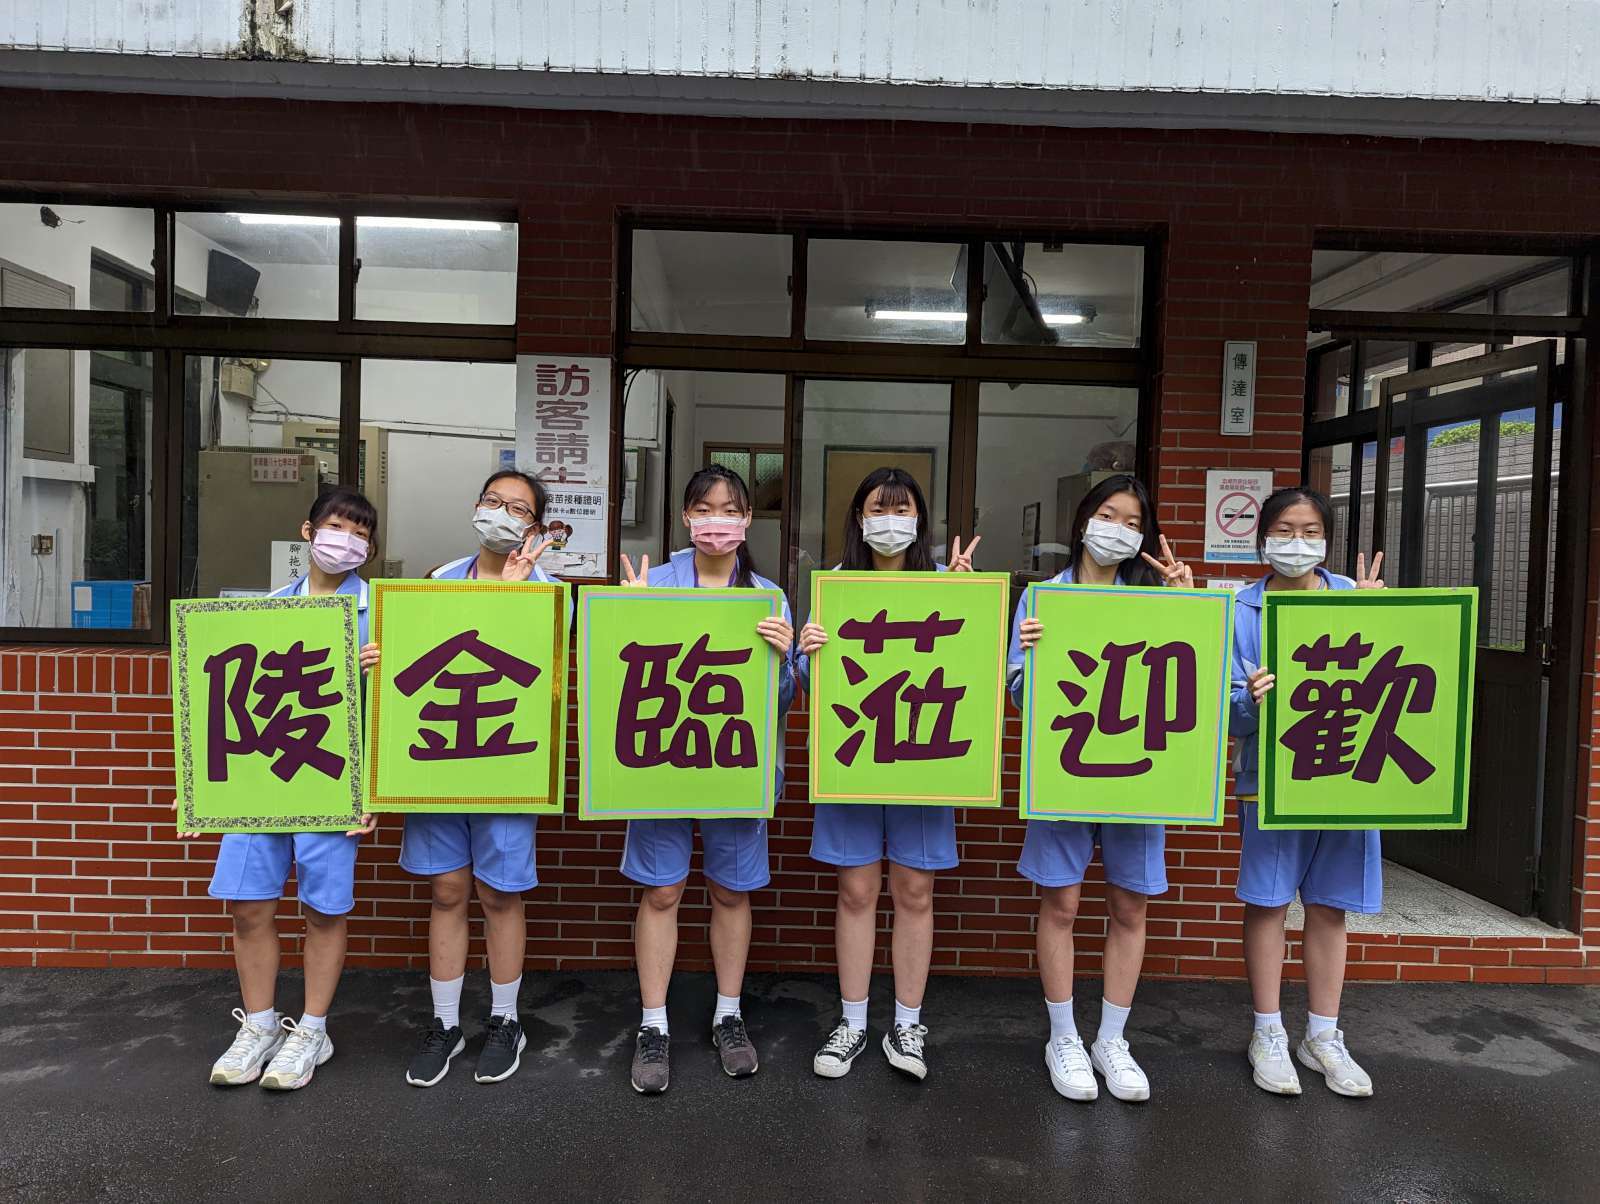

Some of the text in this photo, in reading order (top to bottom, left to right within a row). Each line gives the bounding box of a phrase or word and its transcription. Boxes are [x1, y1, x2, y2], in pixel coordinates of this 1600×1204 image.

[1231, 352, 1249, 424] 傳達室
[203, 640, 346, 782] 陵
[394, 629, 542, 761] 金
[615, 633, 758, 769] 臨
[831, 609, 972, 767] 蒞
[1051, 640, 1197, 778] 迎
[1279, 632, 1437, 784] 歡
